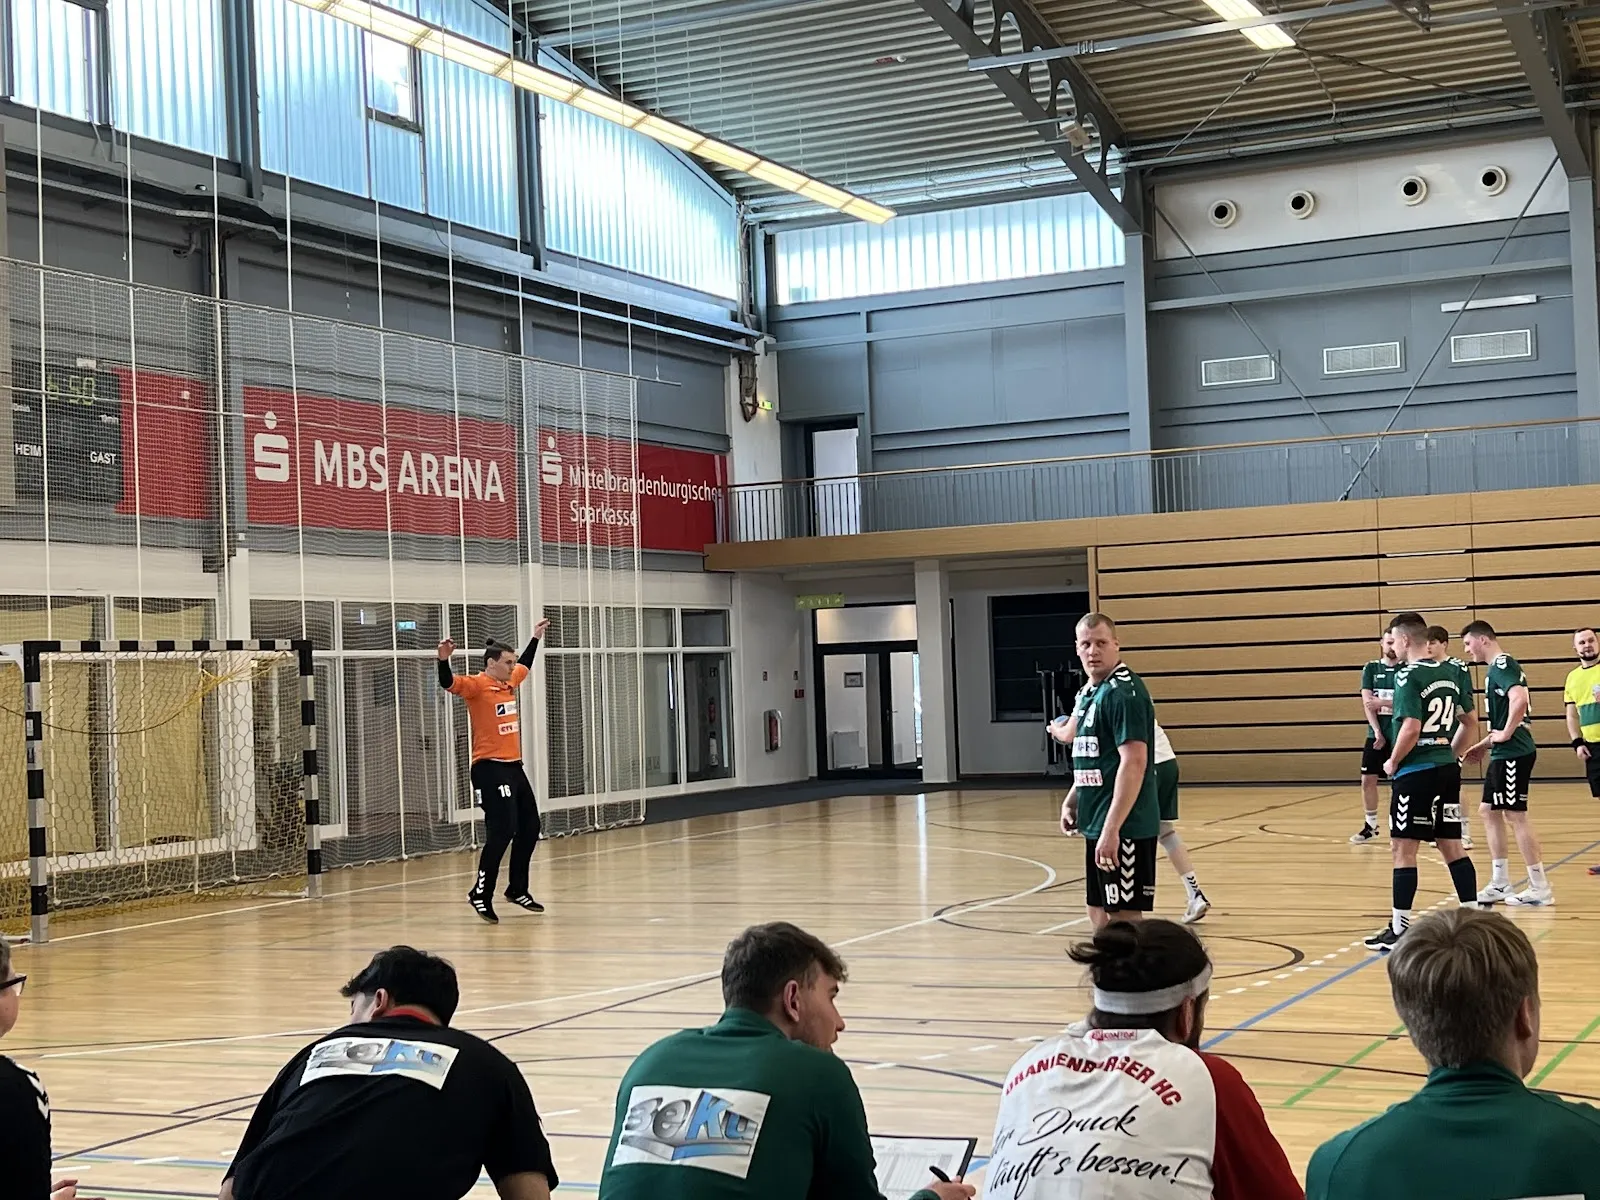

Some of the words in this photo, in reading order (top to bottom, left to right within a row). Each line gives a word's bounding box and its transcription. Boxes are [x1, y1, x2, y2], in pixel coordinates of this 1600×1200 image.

[14, 443, 42, 457] HEIM
[90, 451, 117, 465] GAST
[314, 439, 387, 492] MBS
[396, 450, 505, 503] ARENA
[569, 499, 638, 528] Sparkasse
[1422, 695, 1455, 733] 24
[498, 784, 512, 798] 16
[1104, 883, 1120, 905] 19
[1005, 1052, 1155, 1096] RANIENBRGER
[1150, 1077, 1183, 1107] HC
[1017, 1104, 1140, 1146] Druck
[1077, 1142, 1190, 1185] besser!
